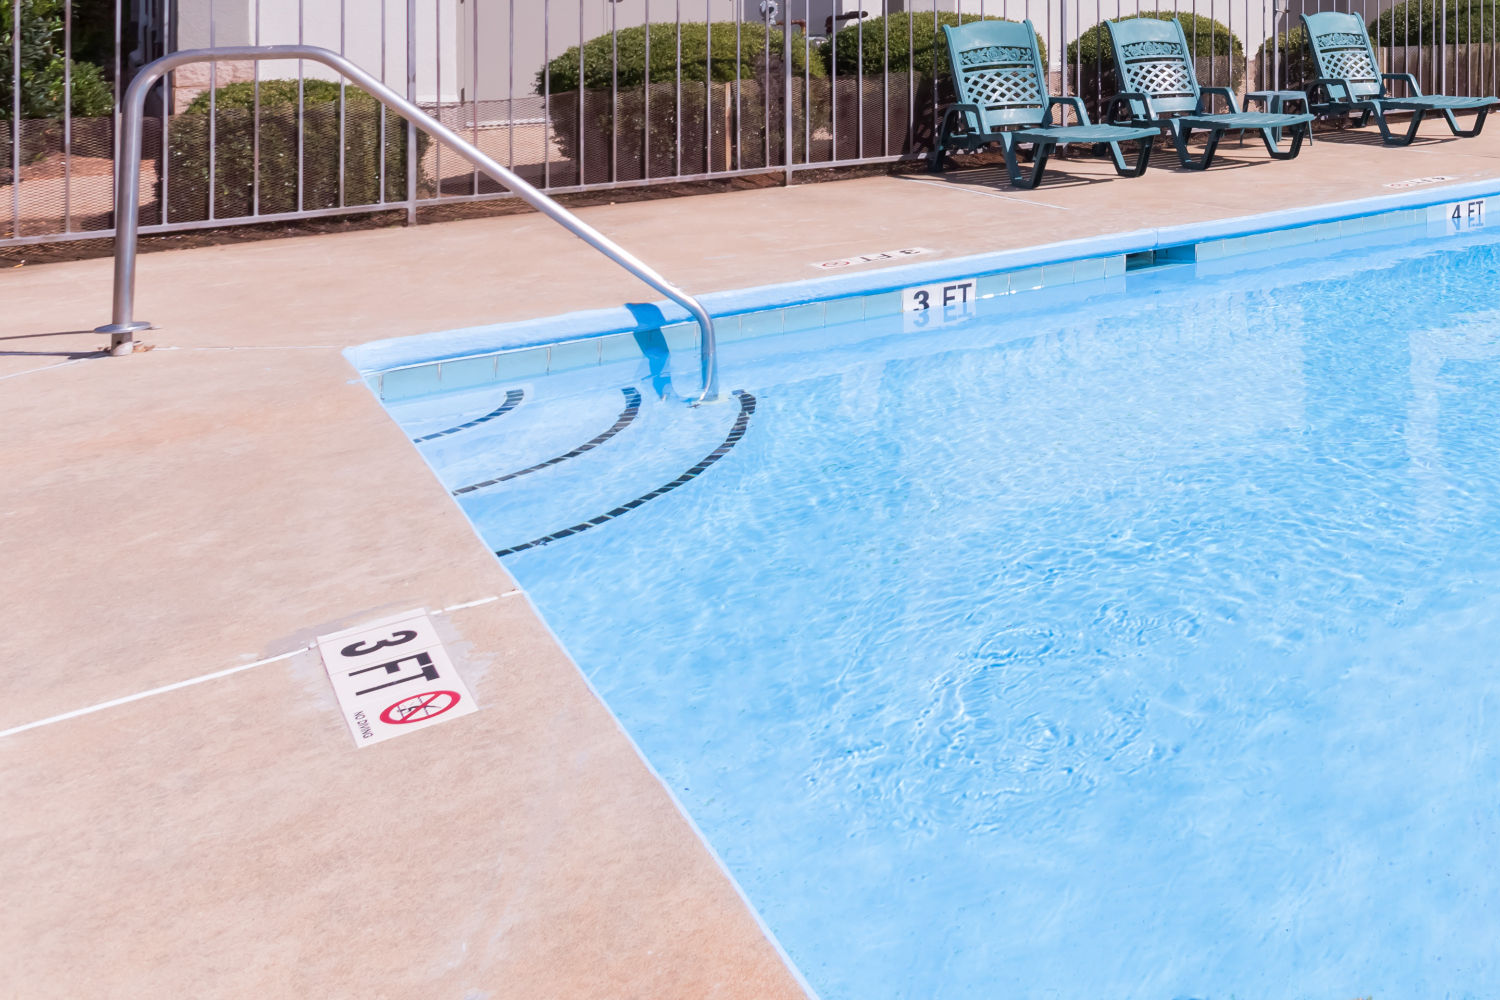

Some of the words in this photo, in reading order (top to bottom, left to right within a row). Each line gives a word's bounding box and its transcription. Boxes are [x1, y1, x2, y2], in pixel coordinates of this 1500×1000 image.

[1452, 204, 1461, 219] 4
[1468, 200, 1484, 217] FT
[913, 290, 930, 311] 3
[943, 283, 972, 306] FT
[340, 630, 418, 657] 3
[348, 651, 440, 696] FT
[354, 710, 366, 720] NO
[357, 719, 374, 739] DIVING
